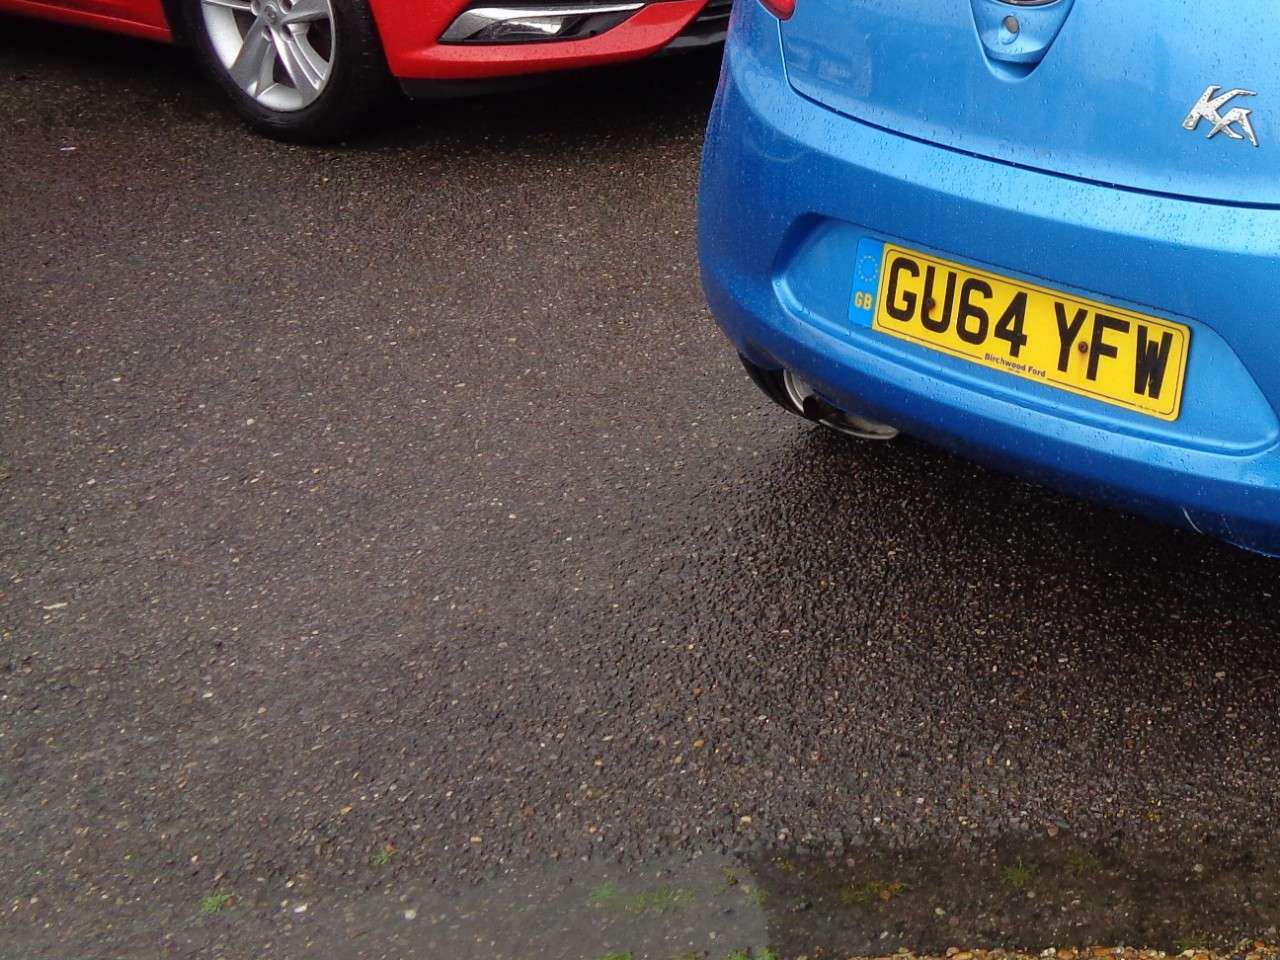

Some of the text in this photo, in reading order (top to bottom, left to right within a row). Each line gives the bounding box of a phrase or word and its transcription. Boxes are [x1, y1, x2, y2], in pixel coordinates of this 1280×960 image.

[854, 291, 873, 310] GB
[885, 257, 1174, 400] GU64 YFW
[984, 352, 1026, 372] Birchwood
[1027, 365, 1046, 377] Ford
